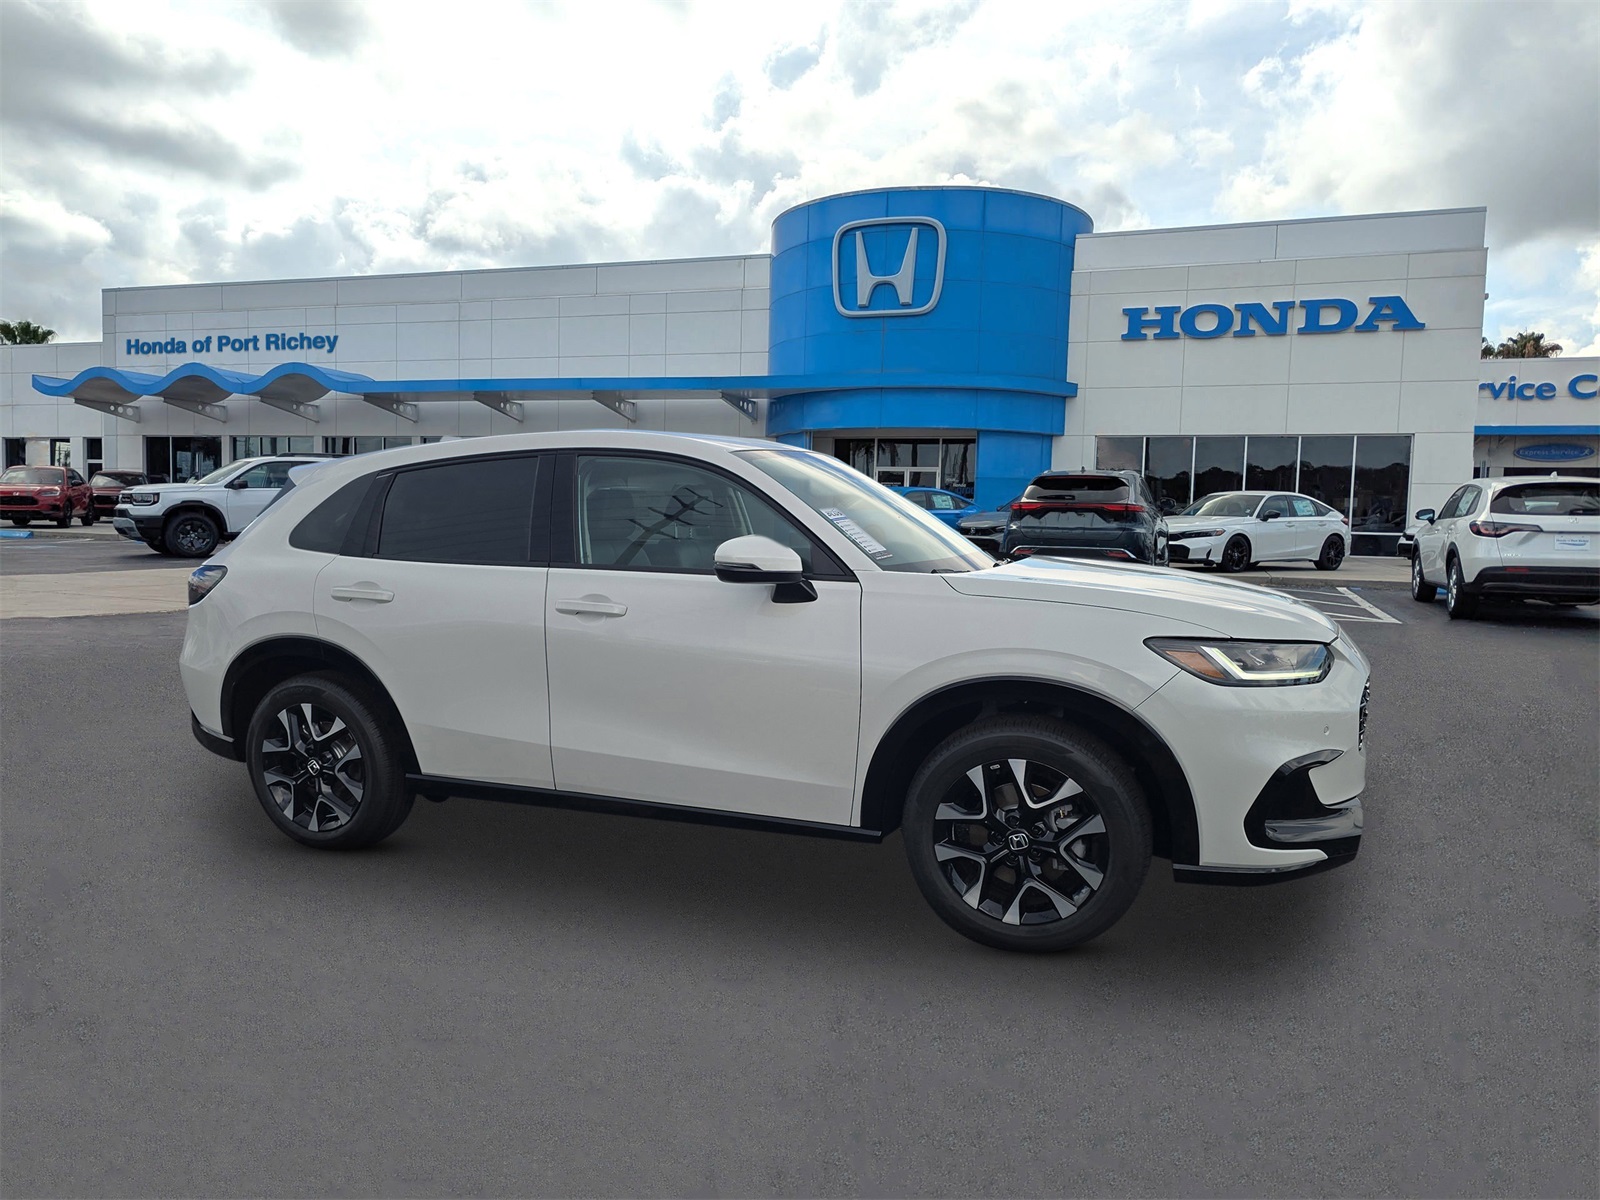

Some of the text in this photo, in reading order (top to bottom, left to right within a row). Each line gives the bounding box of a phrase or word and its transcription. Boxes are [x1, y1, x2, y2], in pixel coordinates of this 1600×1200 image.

[1121, 295, 1426, 341] HONDA
[126, 332, 339, 355] Honda of Port Richey
[1567, 373, 1600, 400] C
